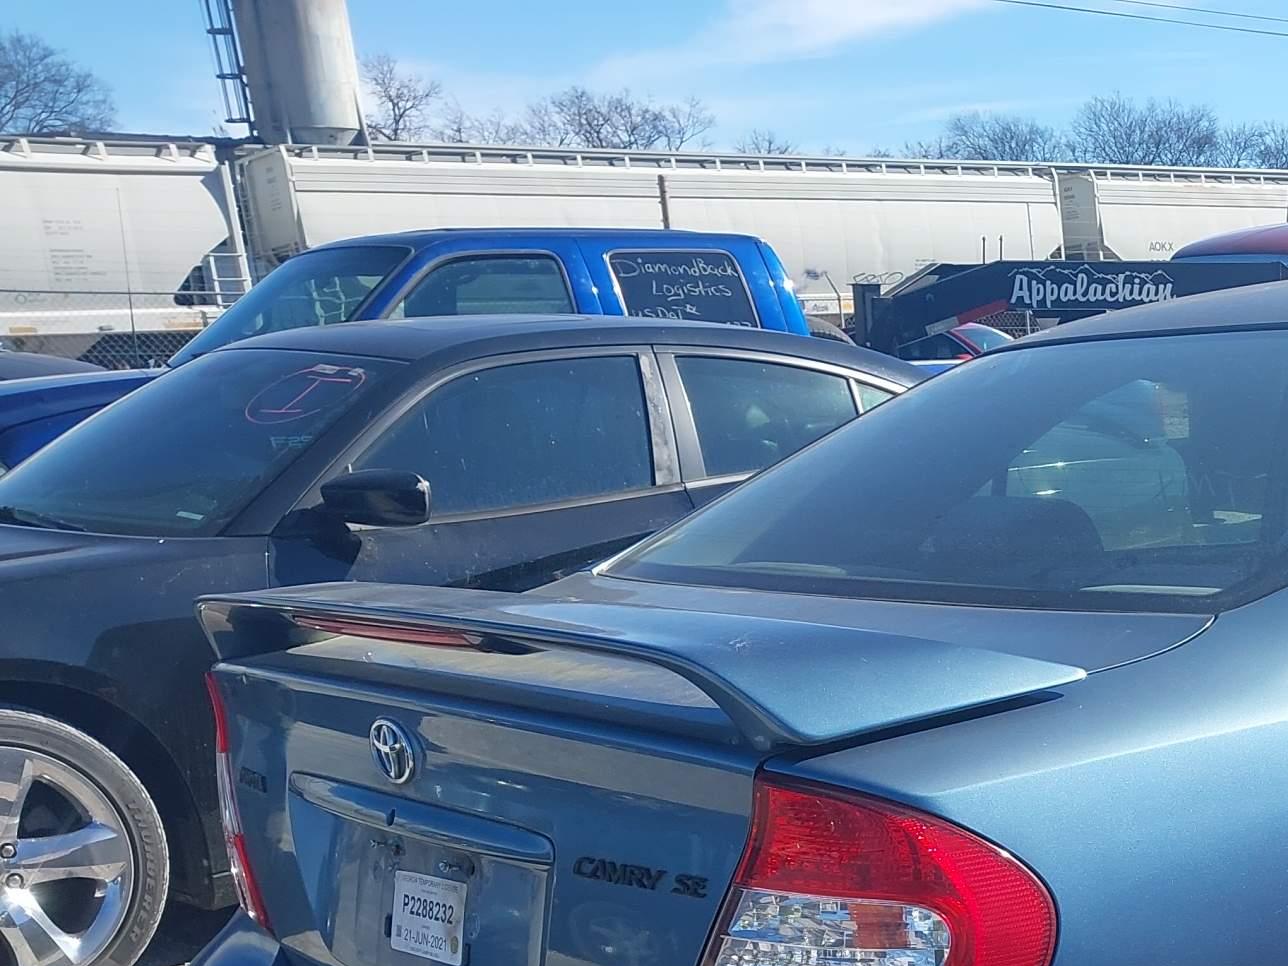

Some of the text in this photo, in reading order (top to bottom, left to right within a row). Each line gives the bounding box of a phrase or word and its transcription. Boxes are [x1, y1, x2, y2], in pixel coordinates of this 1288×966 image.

[652, 279, 732, 301] Logistics
[1010, 273, 1176, 308] Appalachian
[573, 857, 709, 898] CAMRY SE
[402, 893, 454, 924] P2288232
[403, 927, 447, 951] 21-JUN-2021
